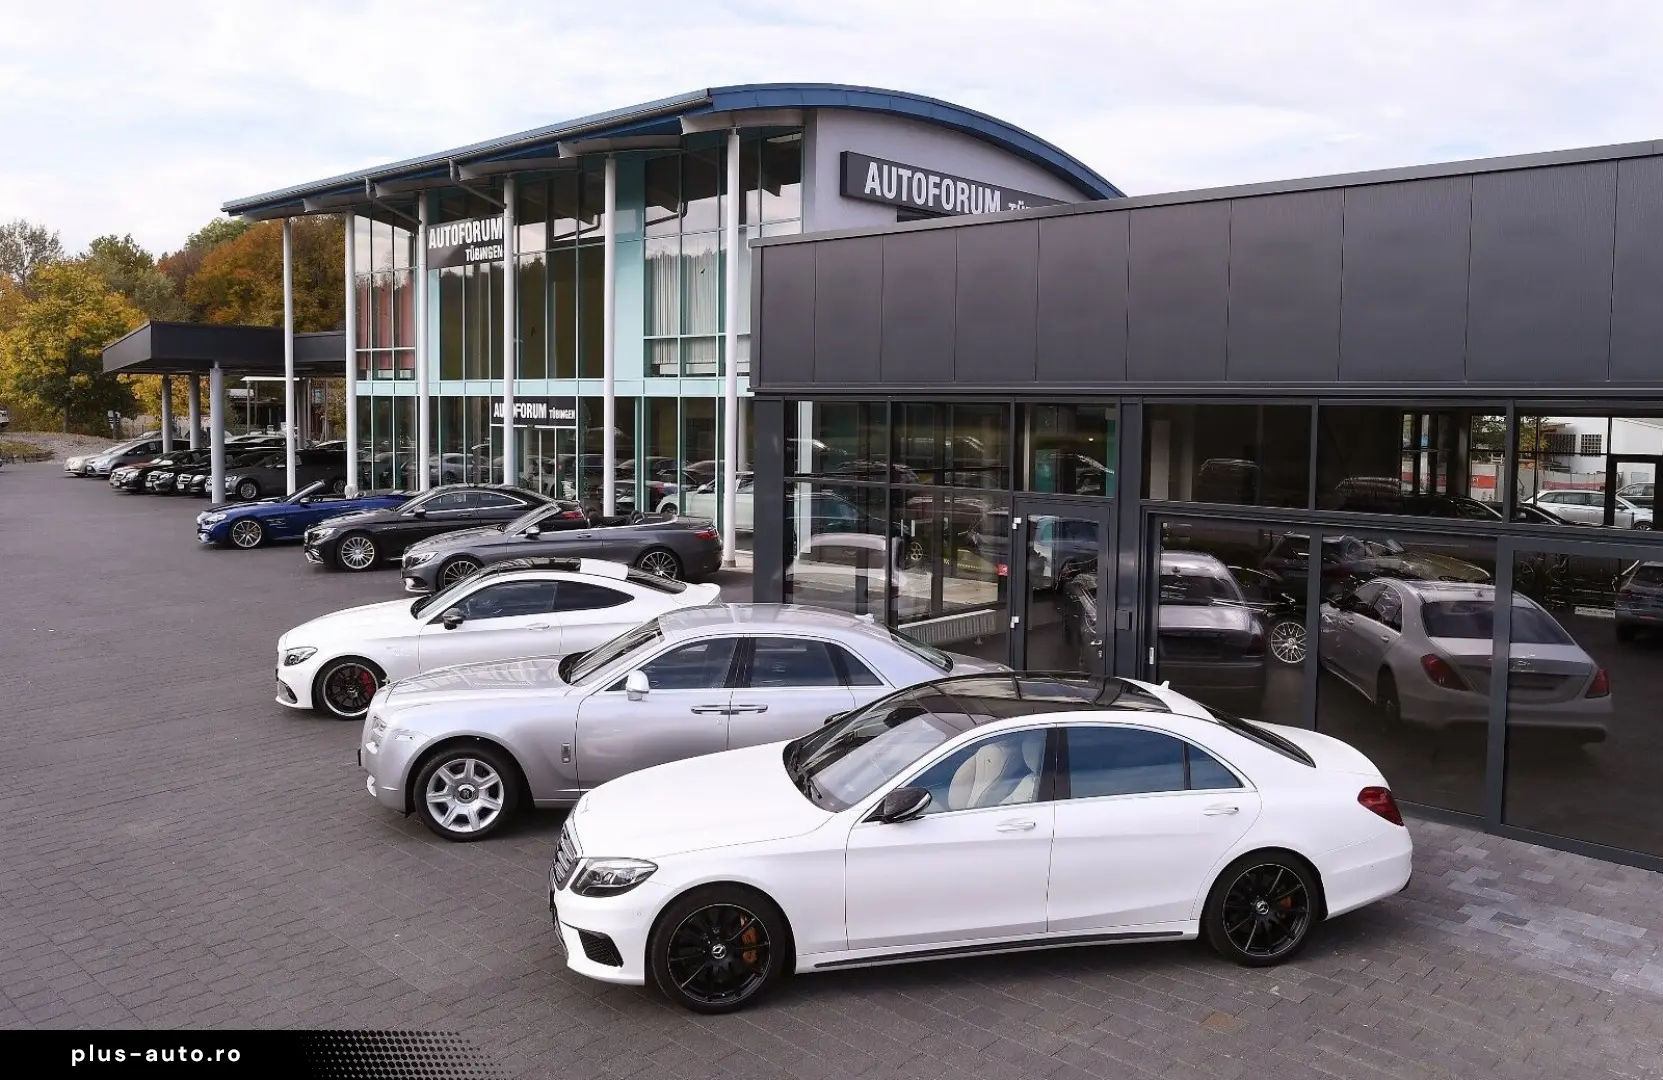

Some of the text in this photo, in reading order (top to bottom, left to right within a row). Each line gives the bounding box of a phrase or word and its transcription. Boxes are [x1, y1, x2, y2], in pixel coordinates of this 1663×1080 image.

[864, 161, 1001, 214] AUTOFORUM
[428, 217, 503, 249] AUTOFORUM
[465, 244, 503, 262] TÜBINGEN
[494, 402, 547, 419] AUFORUM
